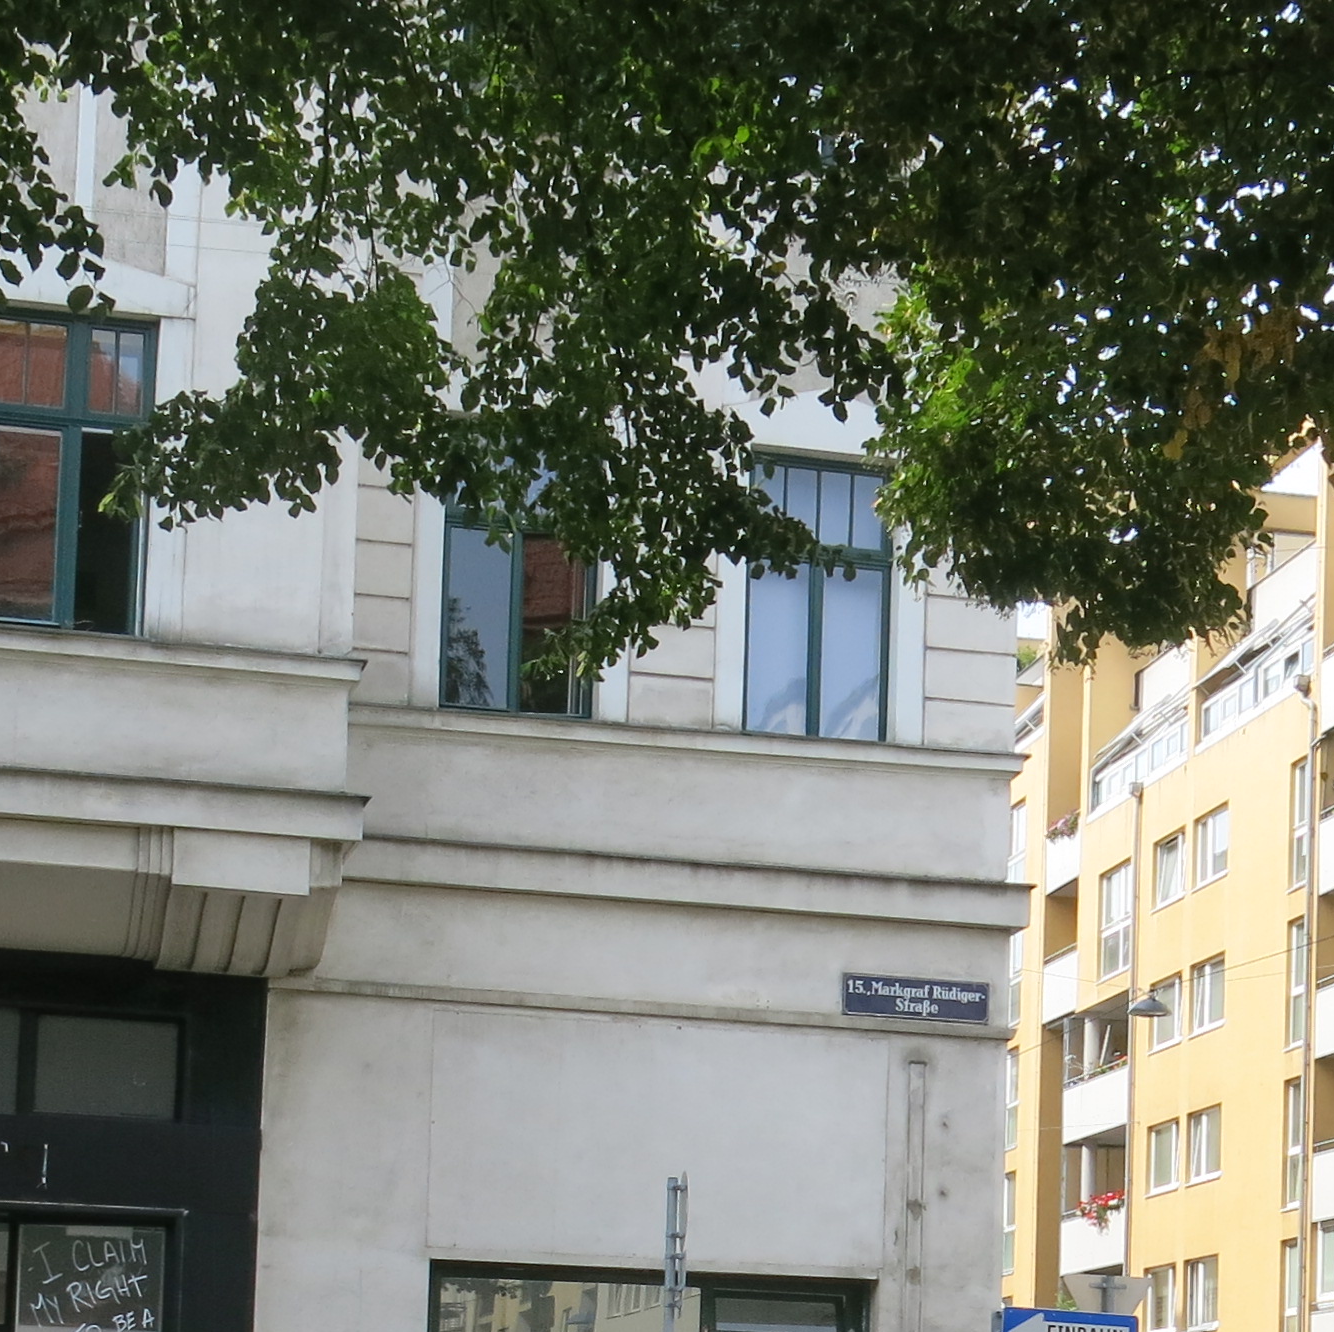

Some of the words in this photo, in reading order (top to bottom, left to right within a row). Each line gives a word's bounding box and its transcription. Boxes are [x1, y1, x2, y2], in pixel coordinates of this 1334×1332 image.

[895, 998, 939, 1016] Straße
[932, 986, 986, 1004] Rüdiger-
[32, 1241, 64, 1284] I
[72, 1239, 147, 1272] CLAIM
[29, 1292, 65, 1328] MY
[66, 1274, 148, 1313] RIGHT
[112, 1311, 136, 1332] BE
[141, 1308, 155, 1328] A
